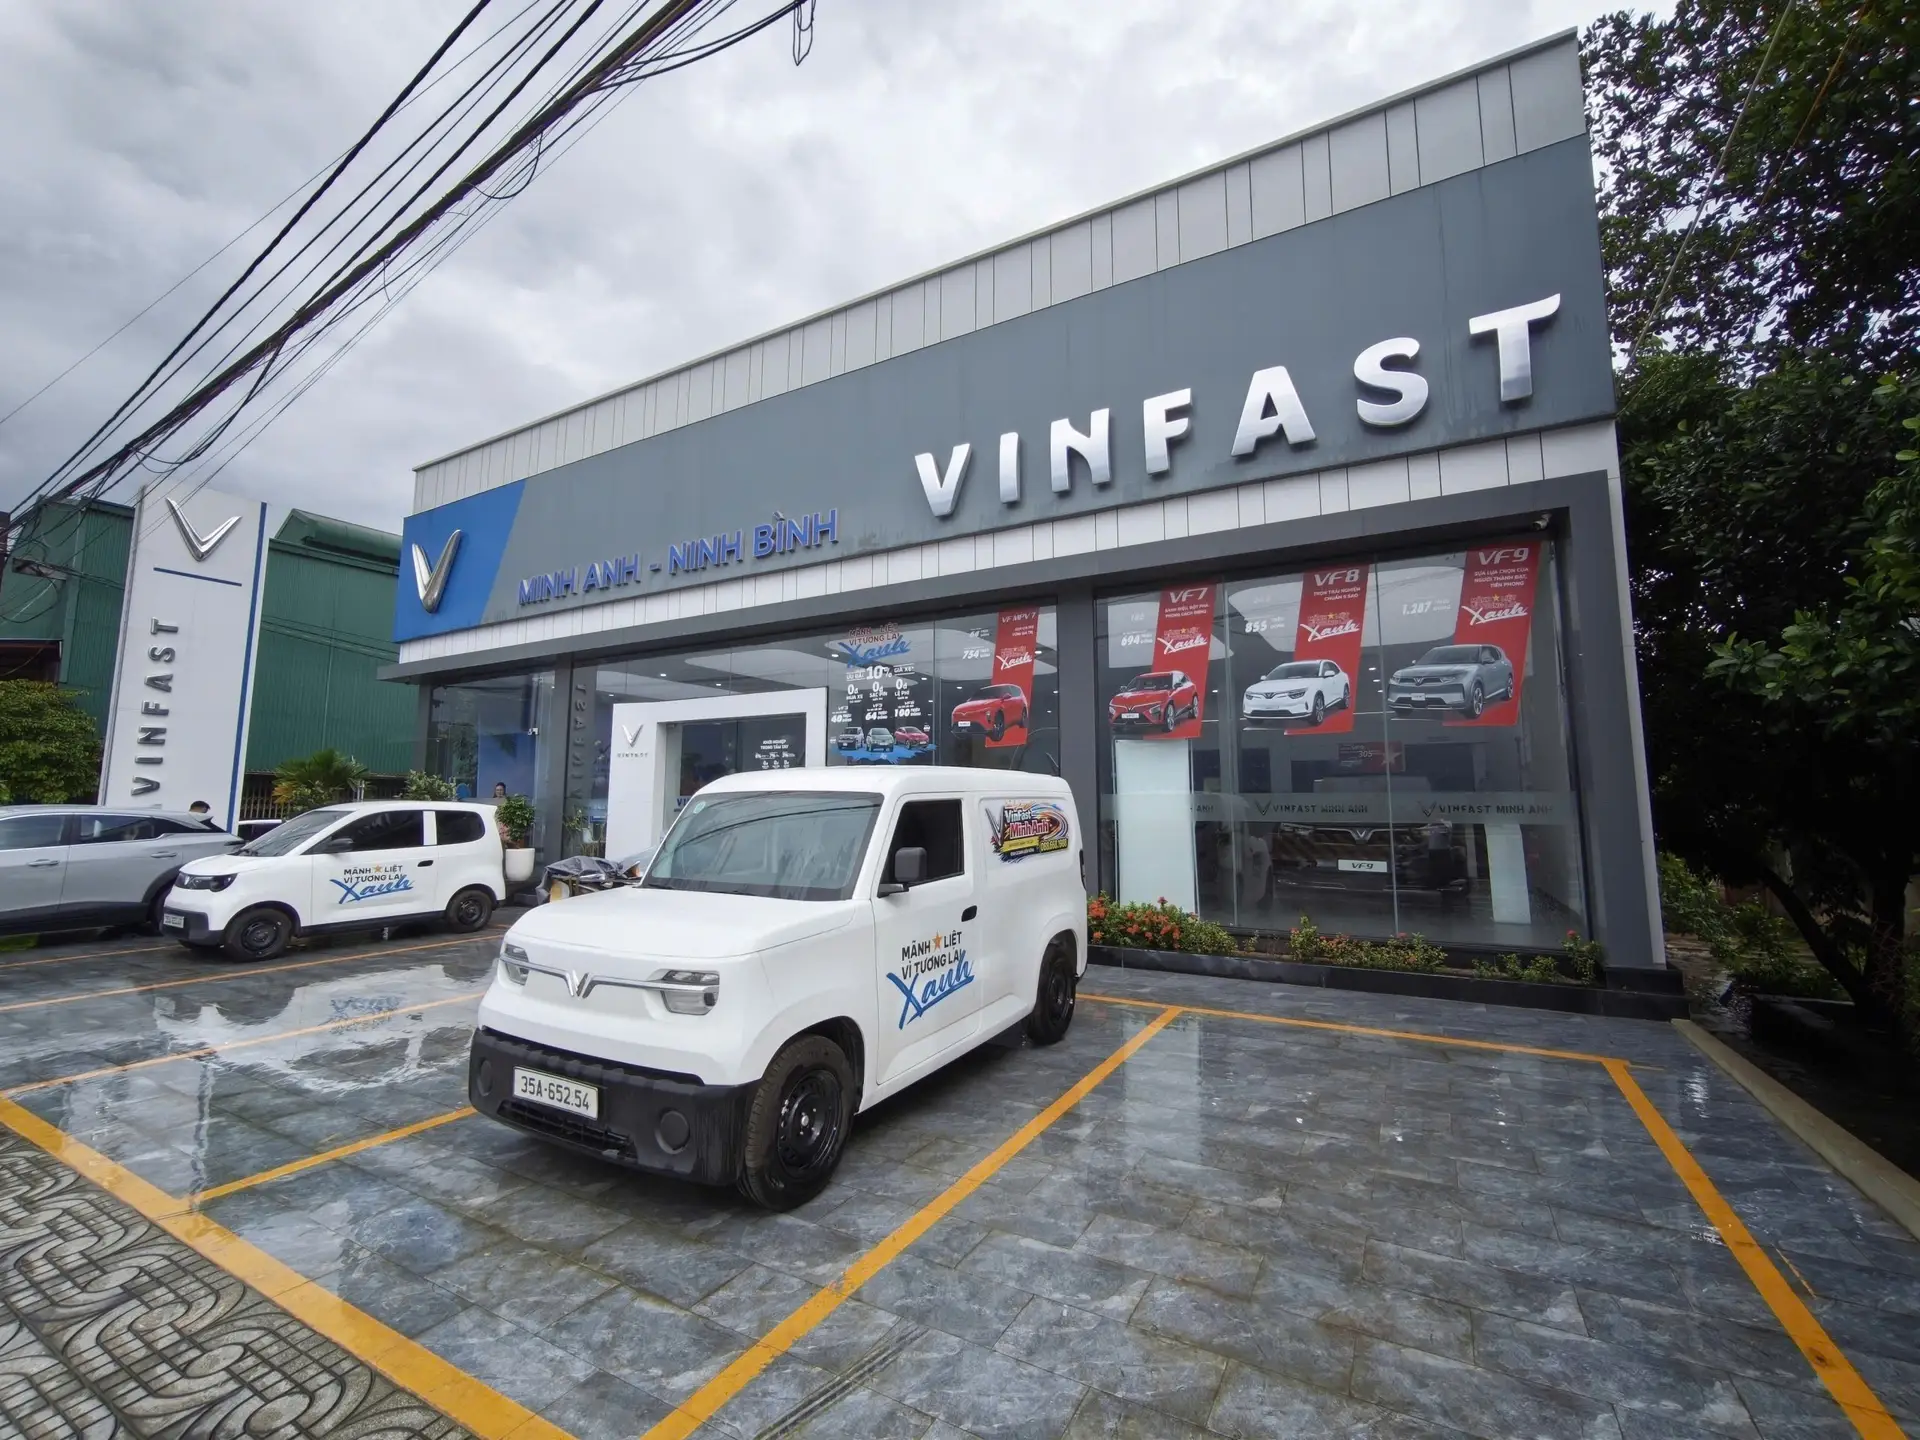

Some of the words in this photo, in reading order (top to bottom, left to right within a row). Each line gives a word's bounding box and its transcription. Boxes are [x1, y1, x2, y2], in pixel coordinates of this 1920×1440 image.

[915, 293, 1561, 516] VINFAST
[518, 567, 577, 606] MINH
[583, 554, 641, 592] ANH
[669, 529, 743, 575] NINH
[753, 508, 838, 558] BÌNH
[1461, 603, 1528, 625] Xanh
[1245, 620, 1267, 633] 855
[1300, 619, 1360, 642] Xanh
[838, 635, 911, 668] Xanh
[962, 650, 980, 660] 754
[1157, 633, 1208, 655] Xanh
[866, 665, 892, 680] 10%
[996, 652, 1033, 671] Xanh
[131, 617, 179, 796] VINFAST
[894, 708, 910, 717] 100
[344, 866, 371, 876] MÃNH
[384, 864, 403, 873] LIỆT
[1351, 862, 1374, 870] VF9
[329, 874, 415, 905] Xanh
[901, 940, 931, 962] MÃNH
[943, 930, 962, 948] LIỆT
[902, 960, 912, 980] VÌ
[914, 953, 946, 974] TƯƠNG
[886, 949, 975, 1030] Xanh
